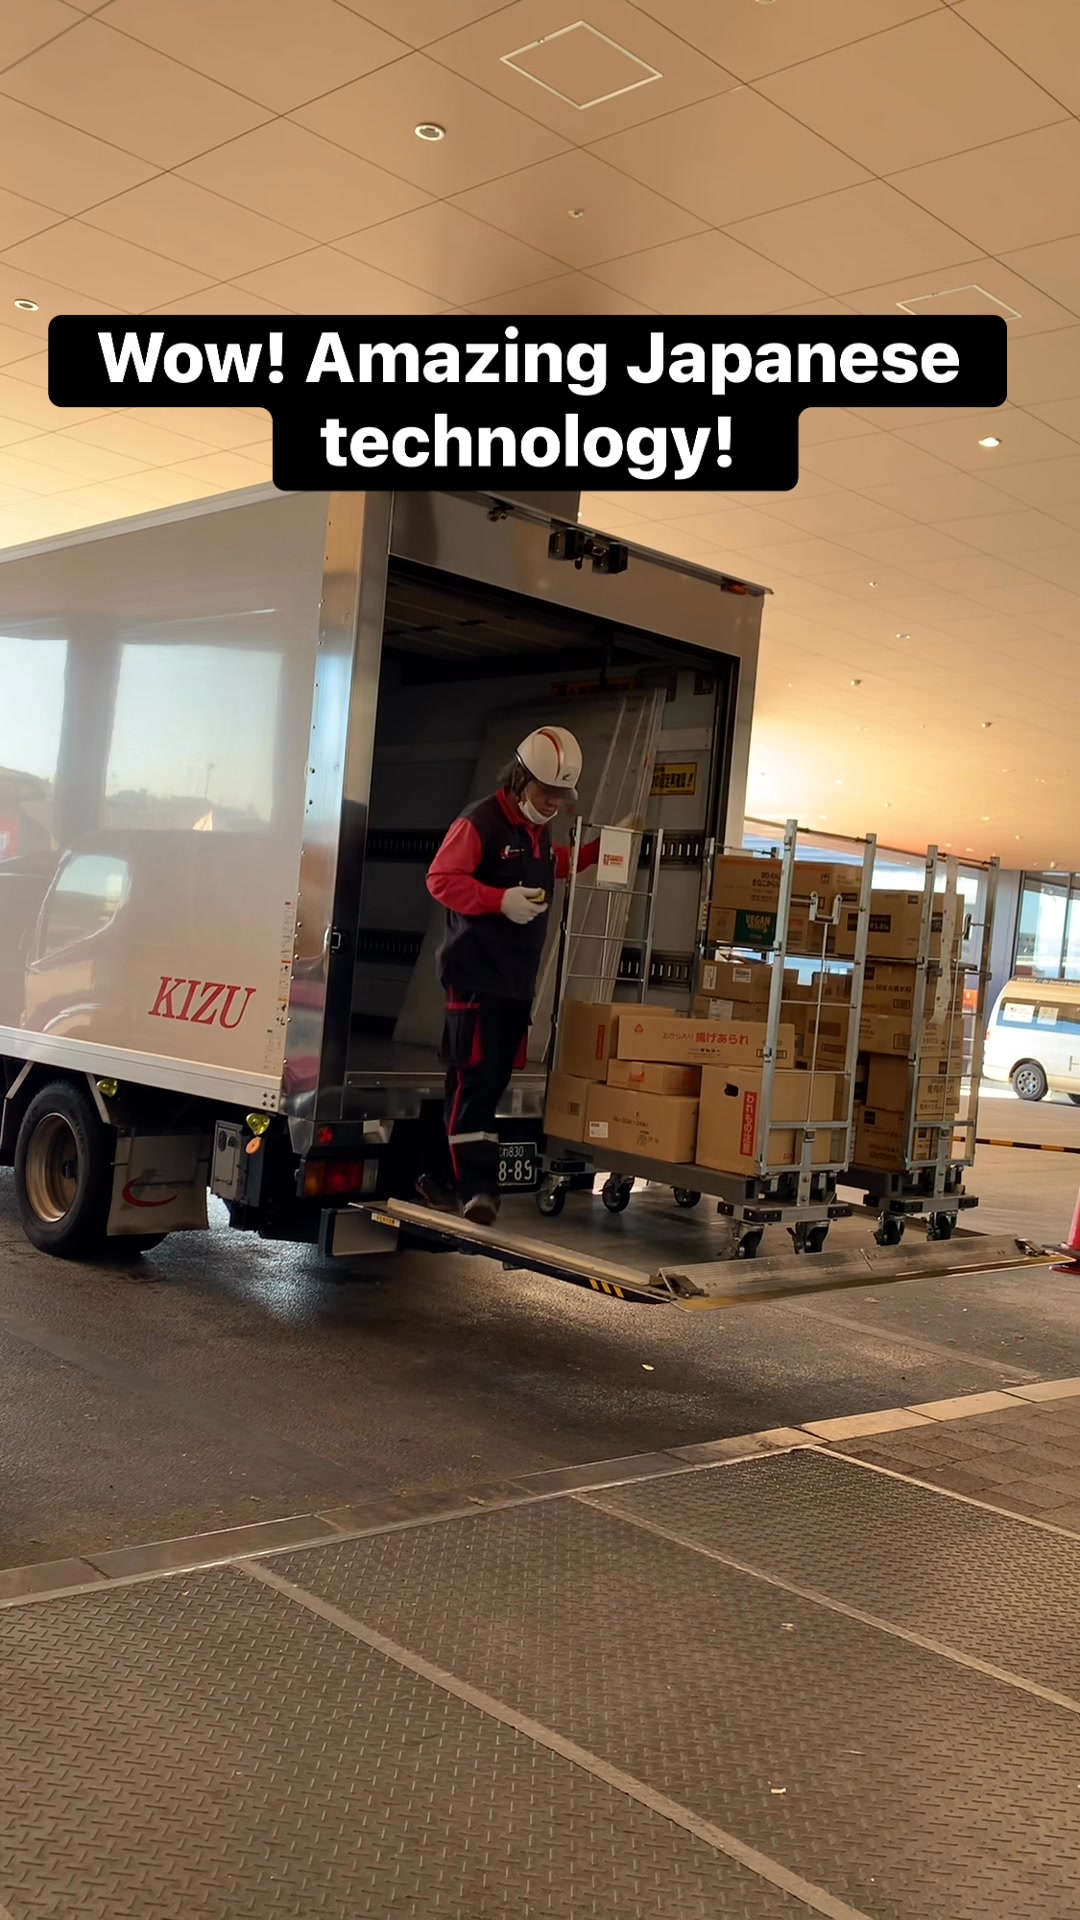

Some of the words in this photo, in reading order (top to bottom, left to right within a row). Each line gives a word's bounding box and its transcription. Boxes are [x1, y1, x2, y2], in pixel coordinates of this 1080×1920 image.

[746, 914, 771, 926] VEGAN
[148, 976, 257, 1029] KIZU
[695, 1032, 749, 1045] 揚げあられ
